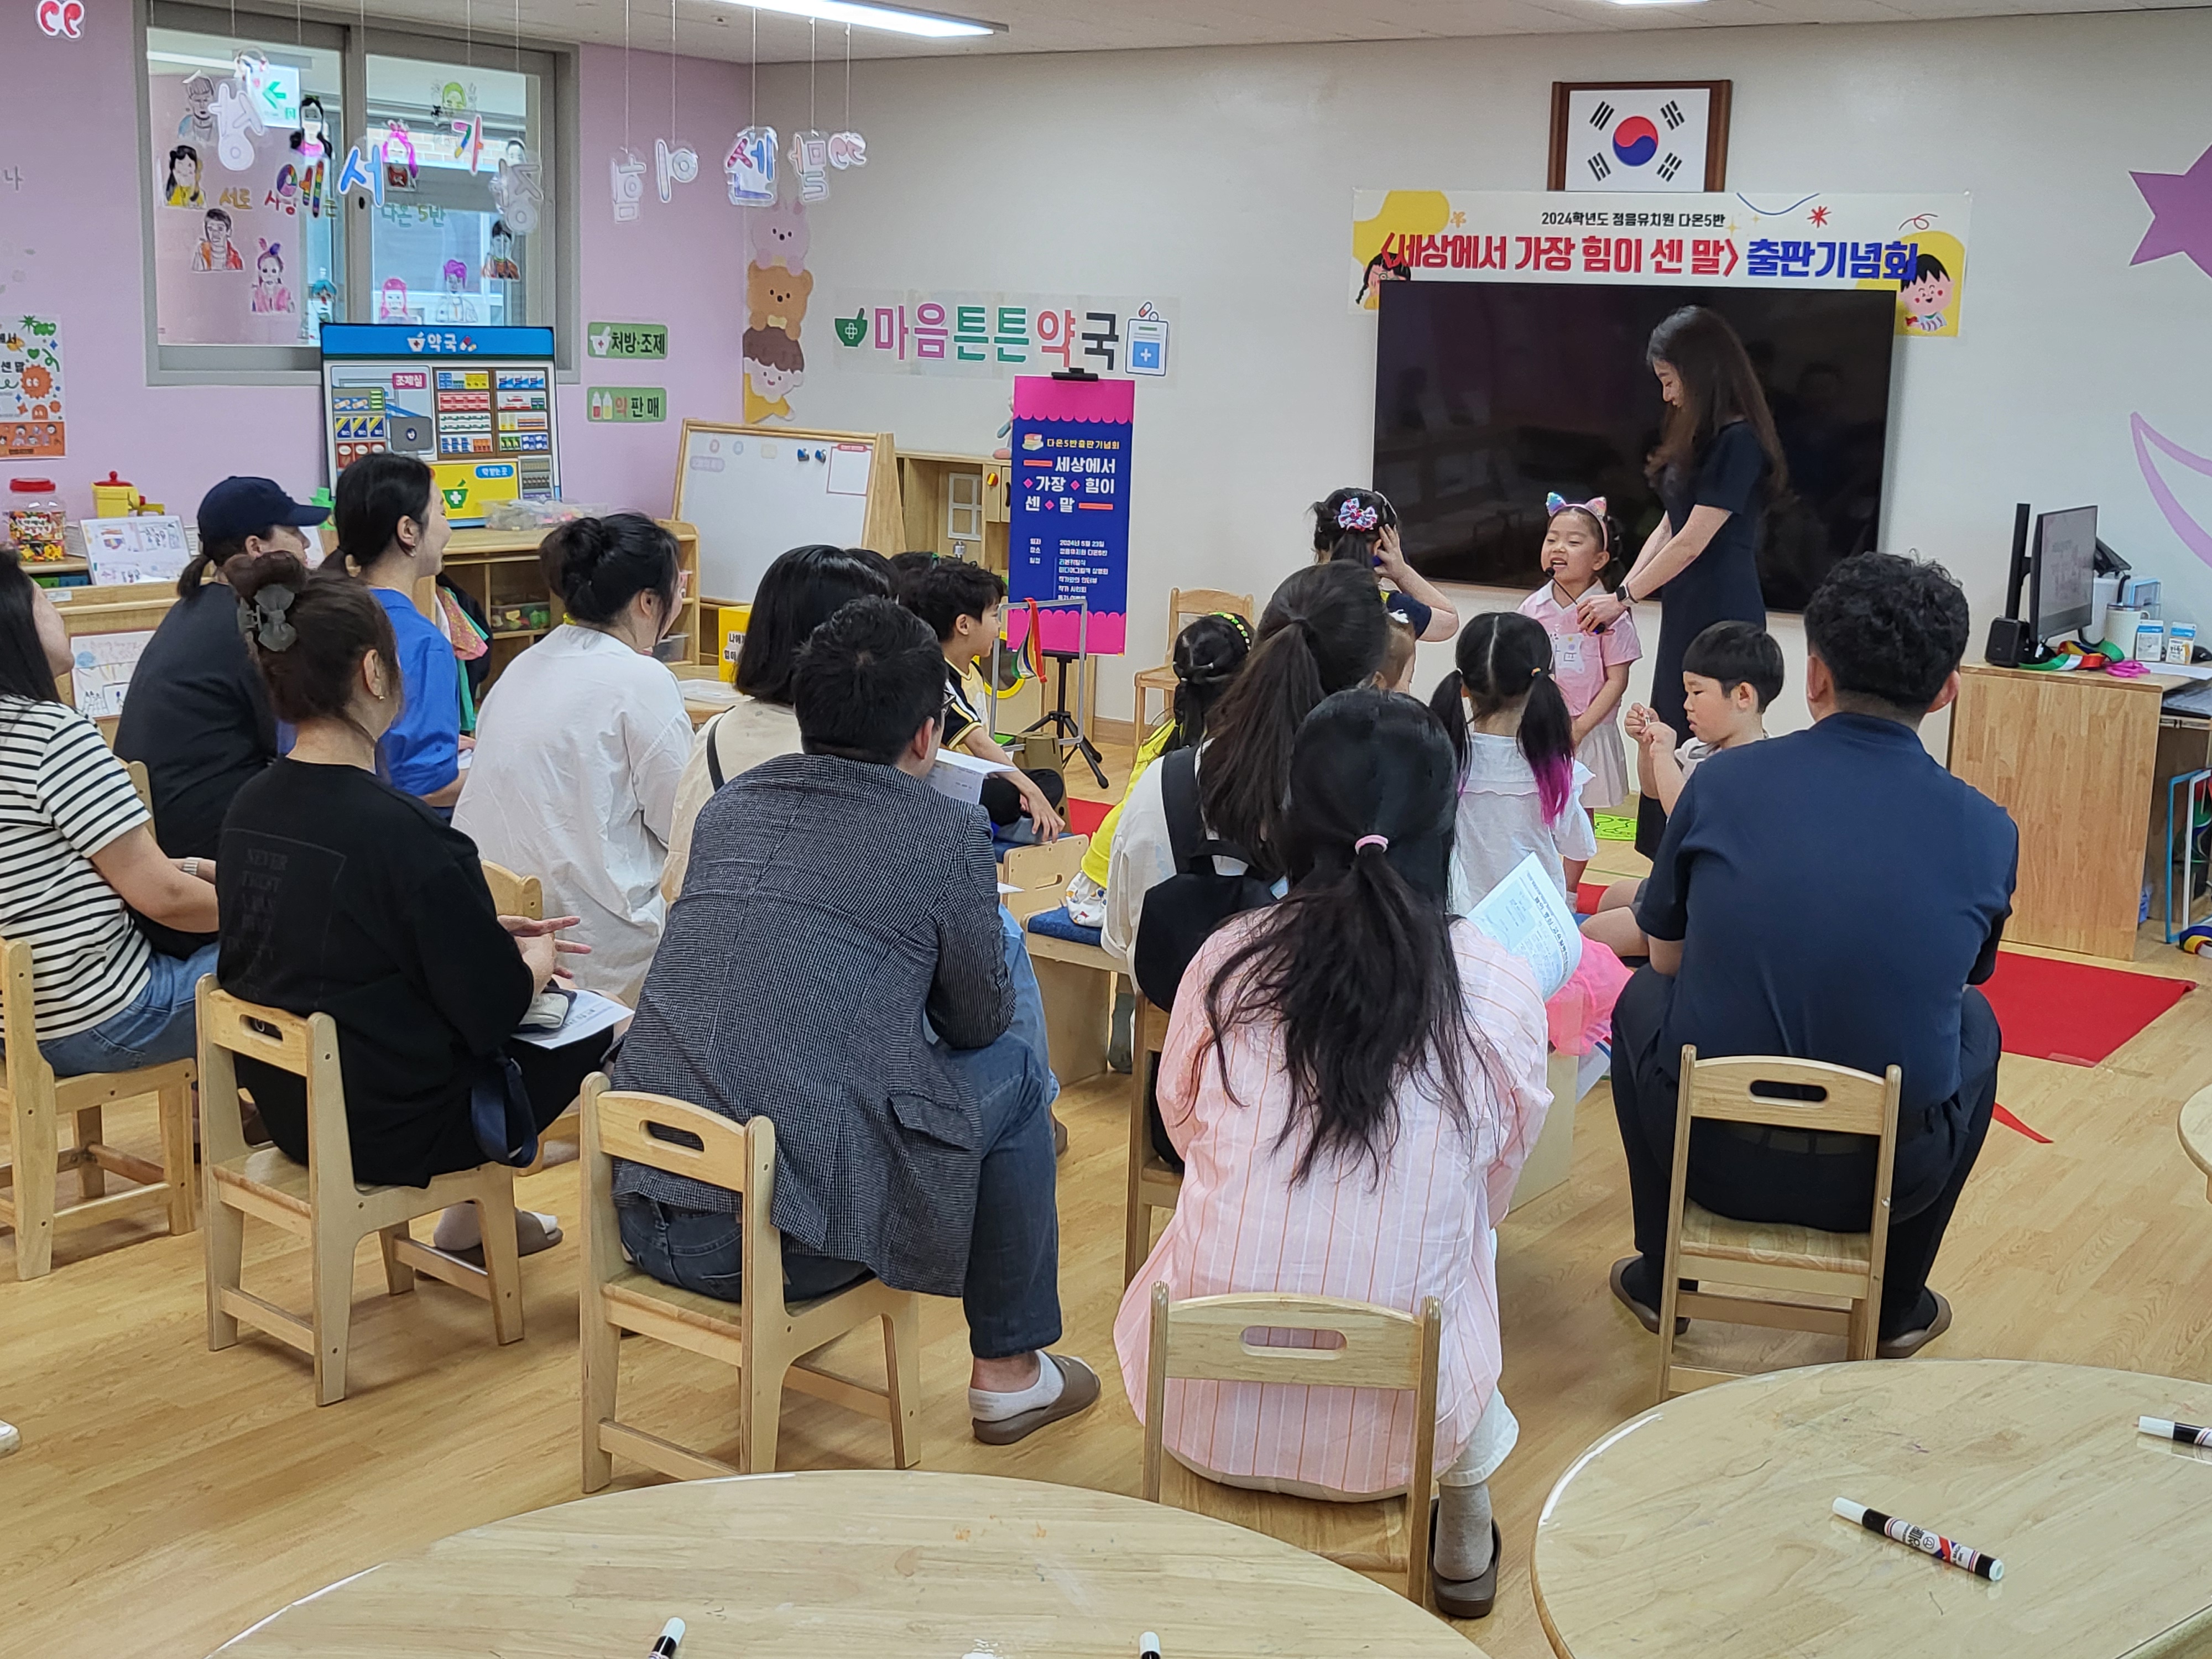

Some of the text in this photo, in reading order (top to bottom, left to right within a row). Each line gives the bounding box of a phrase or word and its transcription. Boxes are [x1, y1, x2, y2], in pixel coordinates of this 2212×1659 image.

[1541, 212, 1609, 226] 2024학년도
[1678, 213, 1726, 227] 다온5반
[1515, 236, 1576, 272] 가장
[1582, 236, 1642, 273] 힘이
[1650, 239, 1683, 274] 센
[1746, 238, 1919, 281] 출판기념회
[427, 333, 458, 352] 약국
[1055, 456, 1115, 474] 세상에서
[1035, 476, 1114, 494] 가장 힘이
[1025, 495, 1075, 513] 센 말
